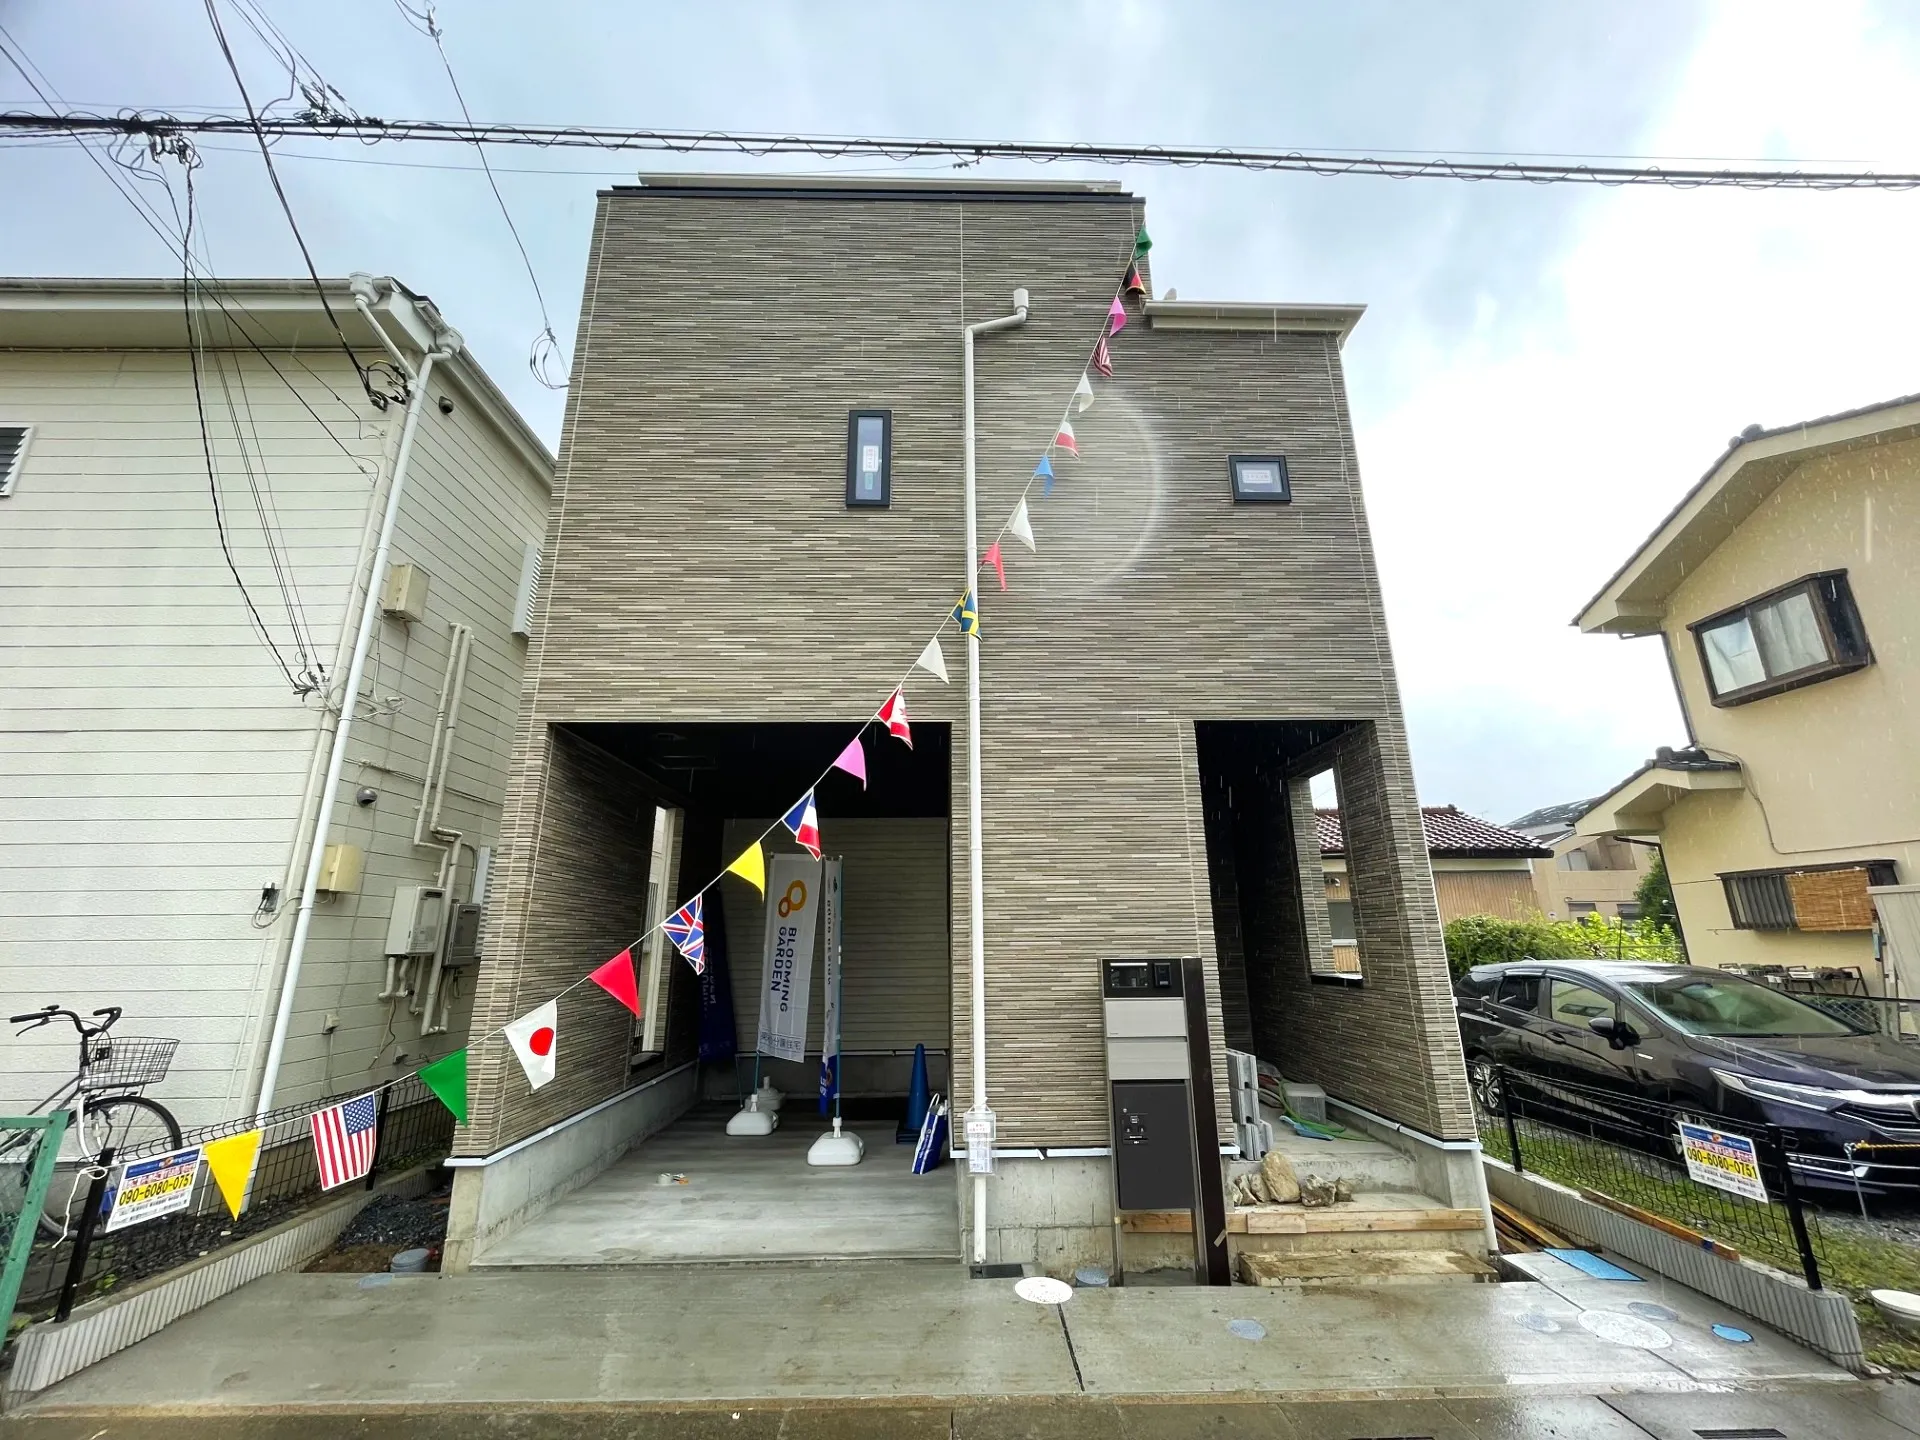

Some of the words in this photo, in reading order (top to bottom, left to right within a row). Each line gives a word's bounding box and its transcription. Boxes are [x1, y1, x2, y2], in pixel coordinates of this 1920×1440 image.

[770, 926, 788, 992] GARDEN
[779, 926, 798, 1013] BLOOMING
[1686, 1146, 1758, 1180] 090-6080-0751
[119, 1172, 194, 1206] 090-6080-0751
